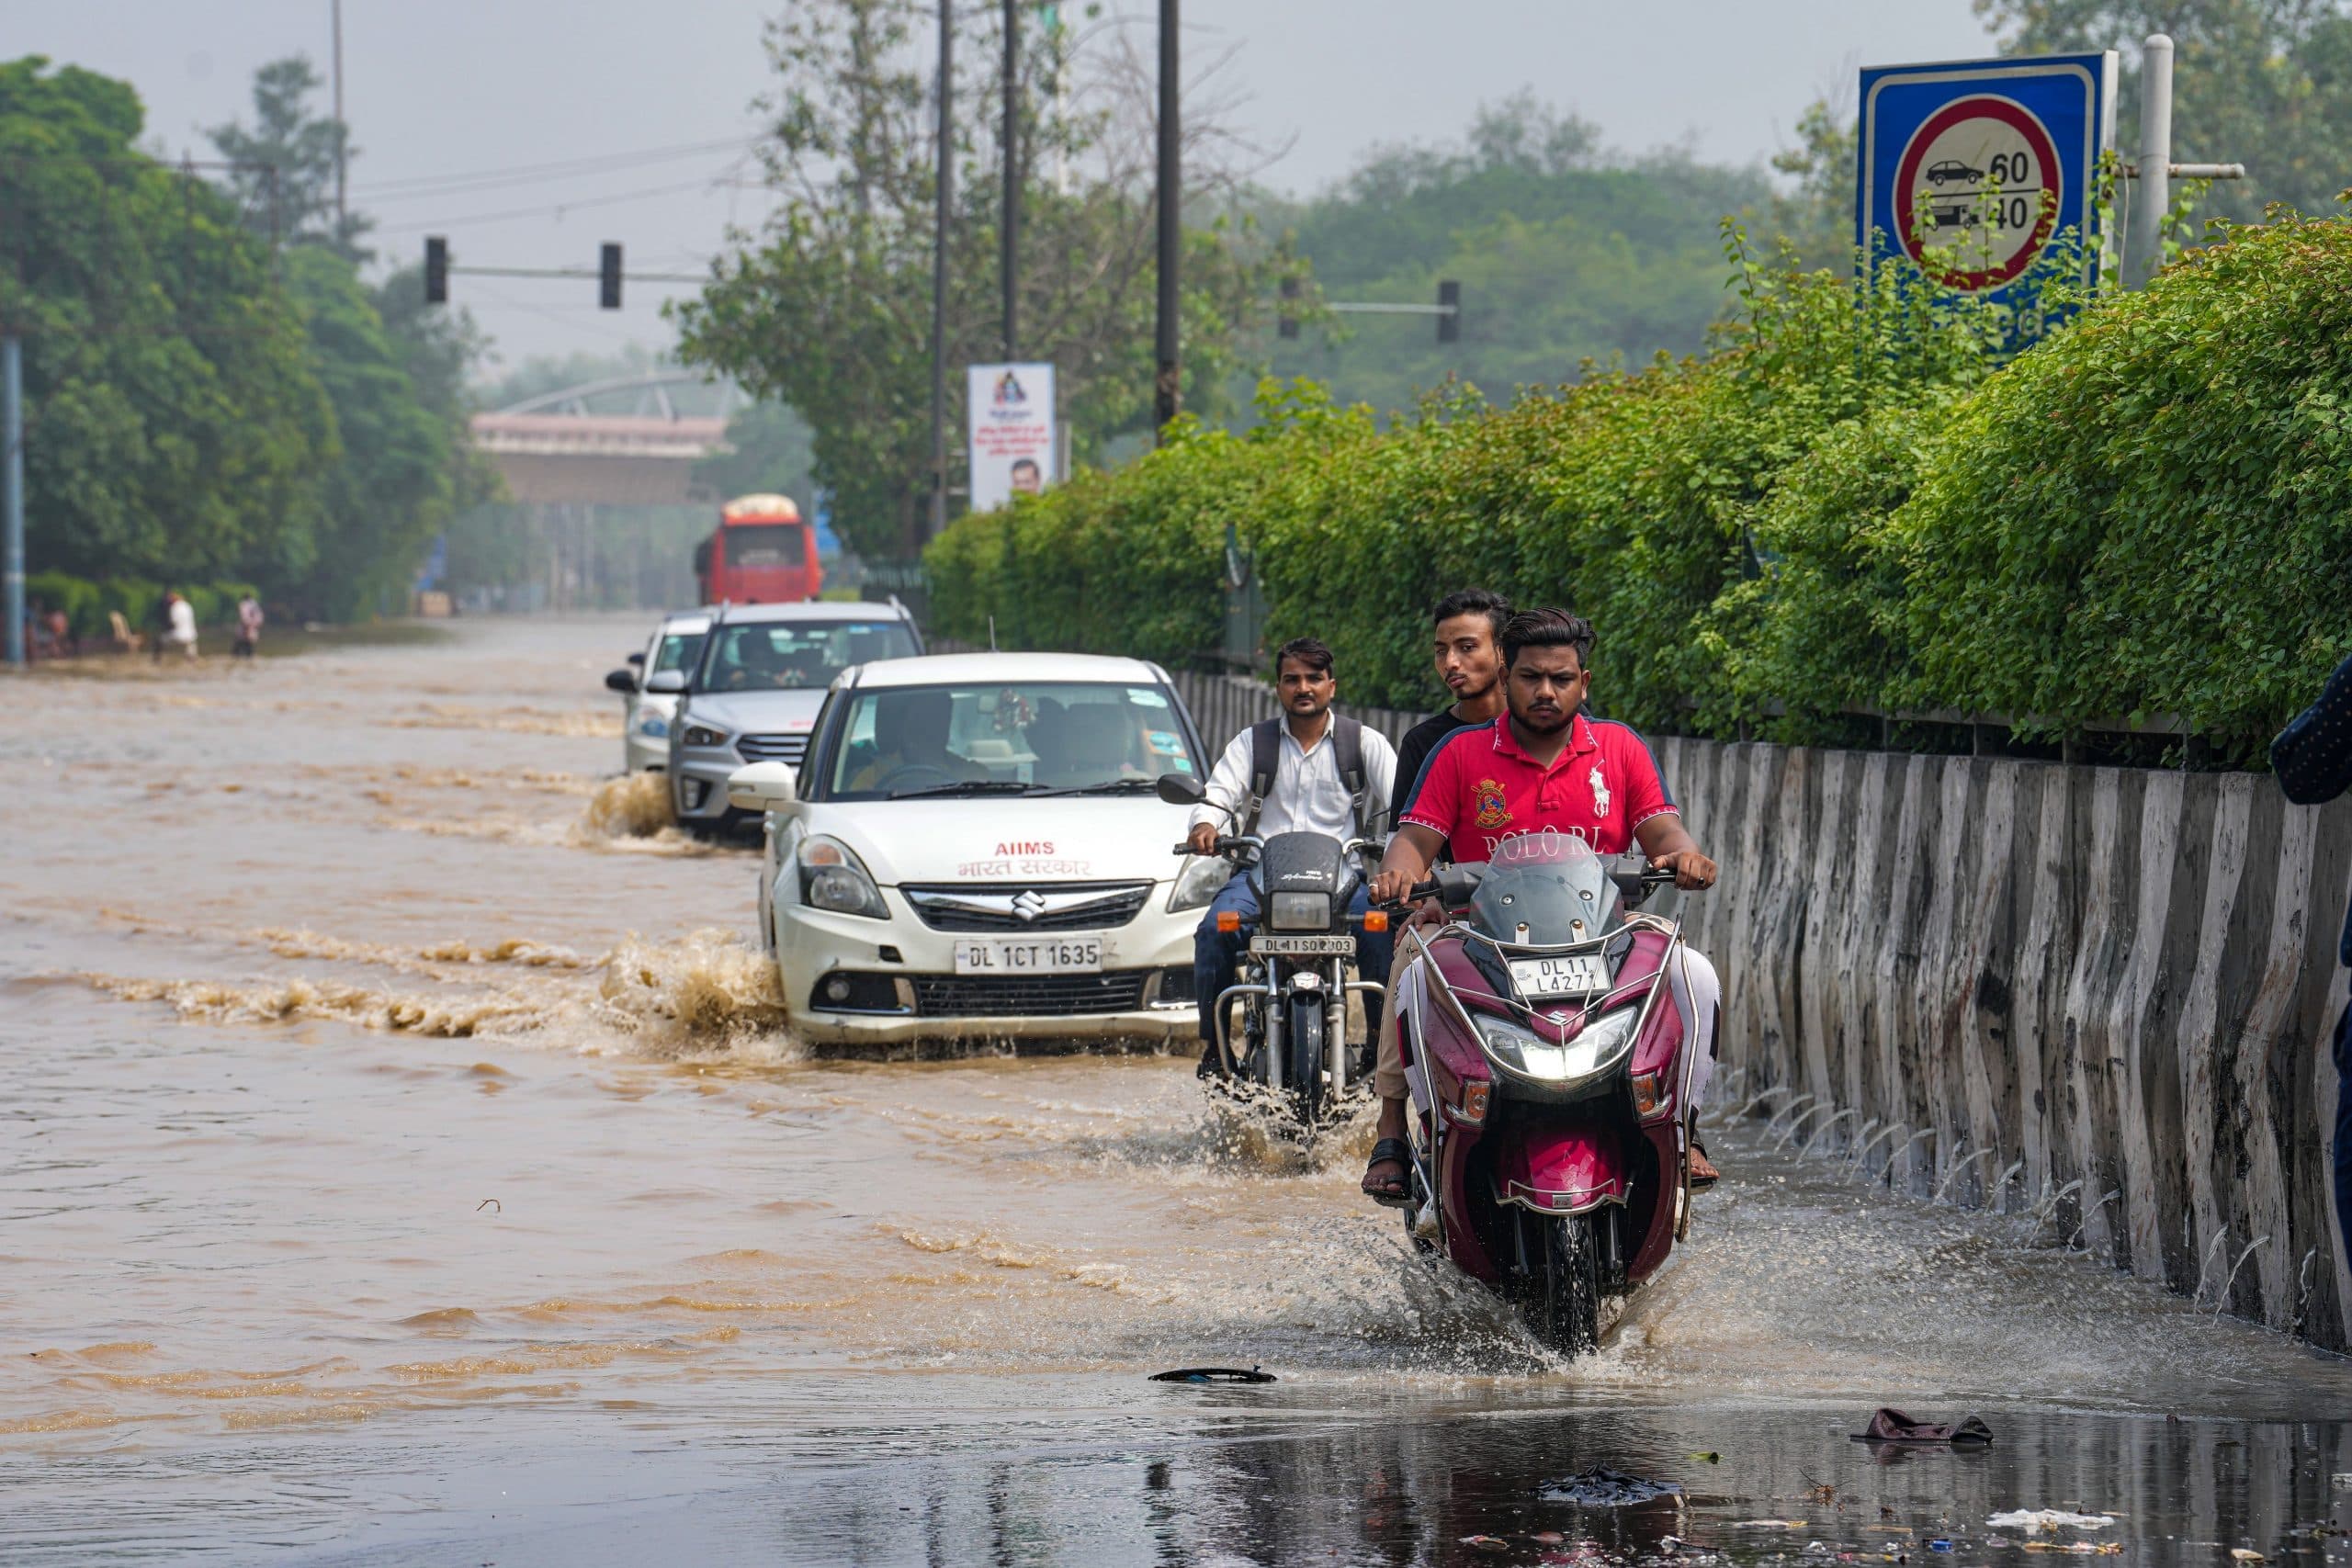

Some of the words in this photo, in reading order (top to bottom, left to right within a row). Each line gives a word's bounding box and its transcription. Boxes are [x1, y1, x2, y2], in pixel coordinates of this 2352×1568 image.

[1990, 152, 2029, 186] 60
[995, 841, 1055, 856] AIIMS
[1481, 824, 1560, 862] POLO
[1568, 826, 1608, 855] RL
[957, 860, 1012, 877] भारत
[1020, 859, 1093, 876] सरकार
[969, 947, 995, 967] DL
[1004, 946, 1038, 967] 1CT
[1049, 945, 1098, 966] 1635
